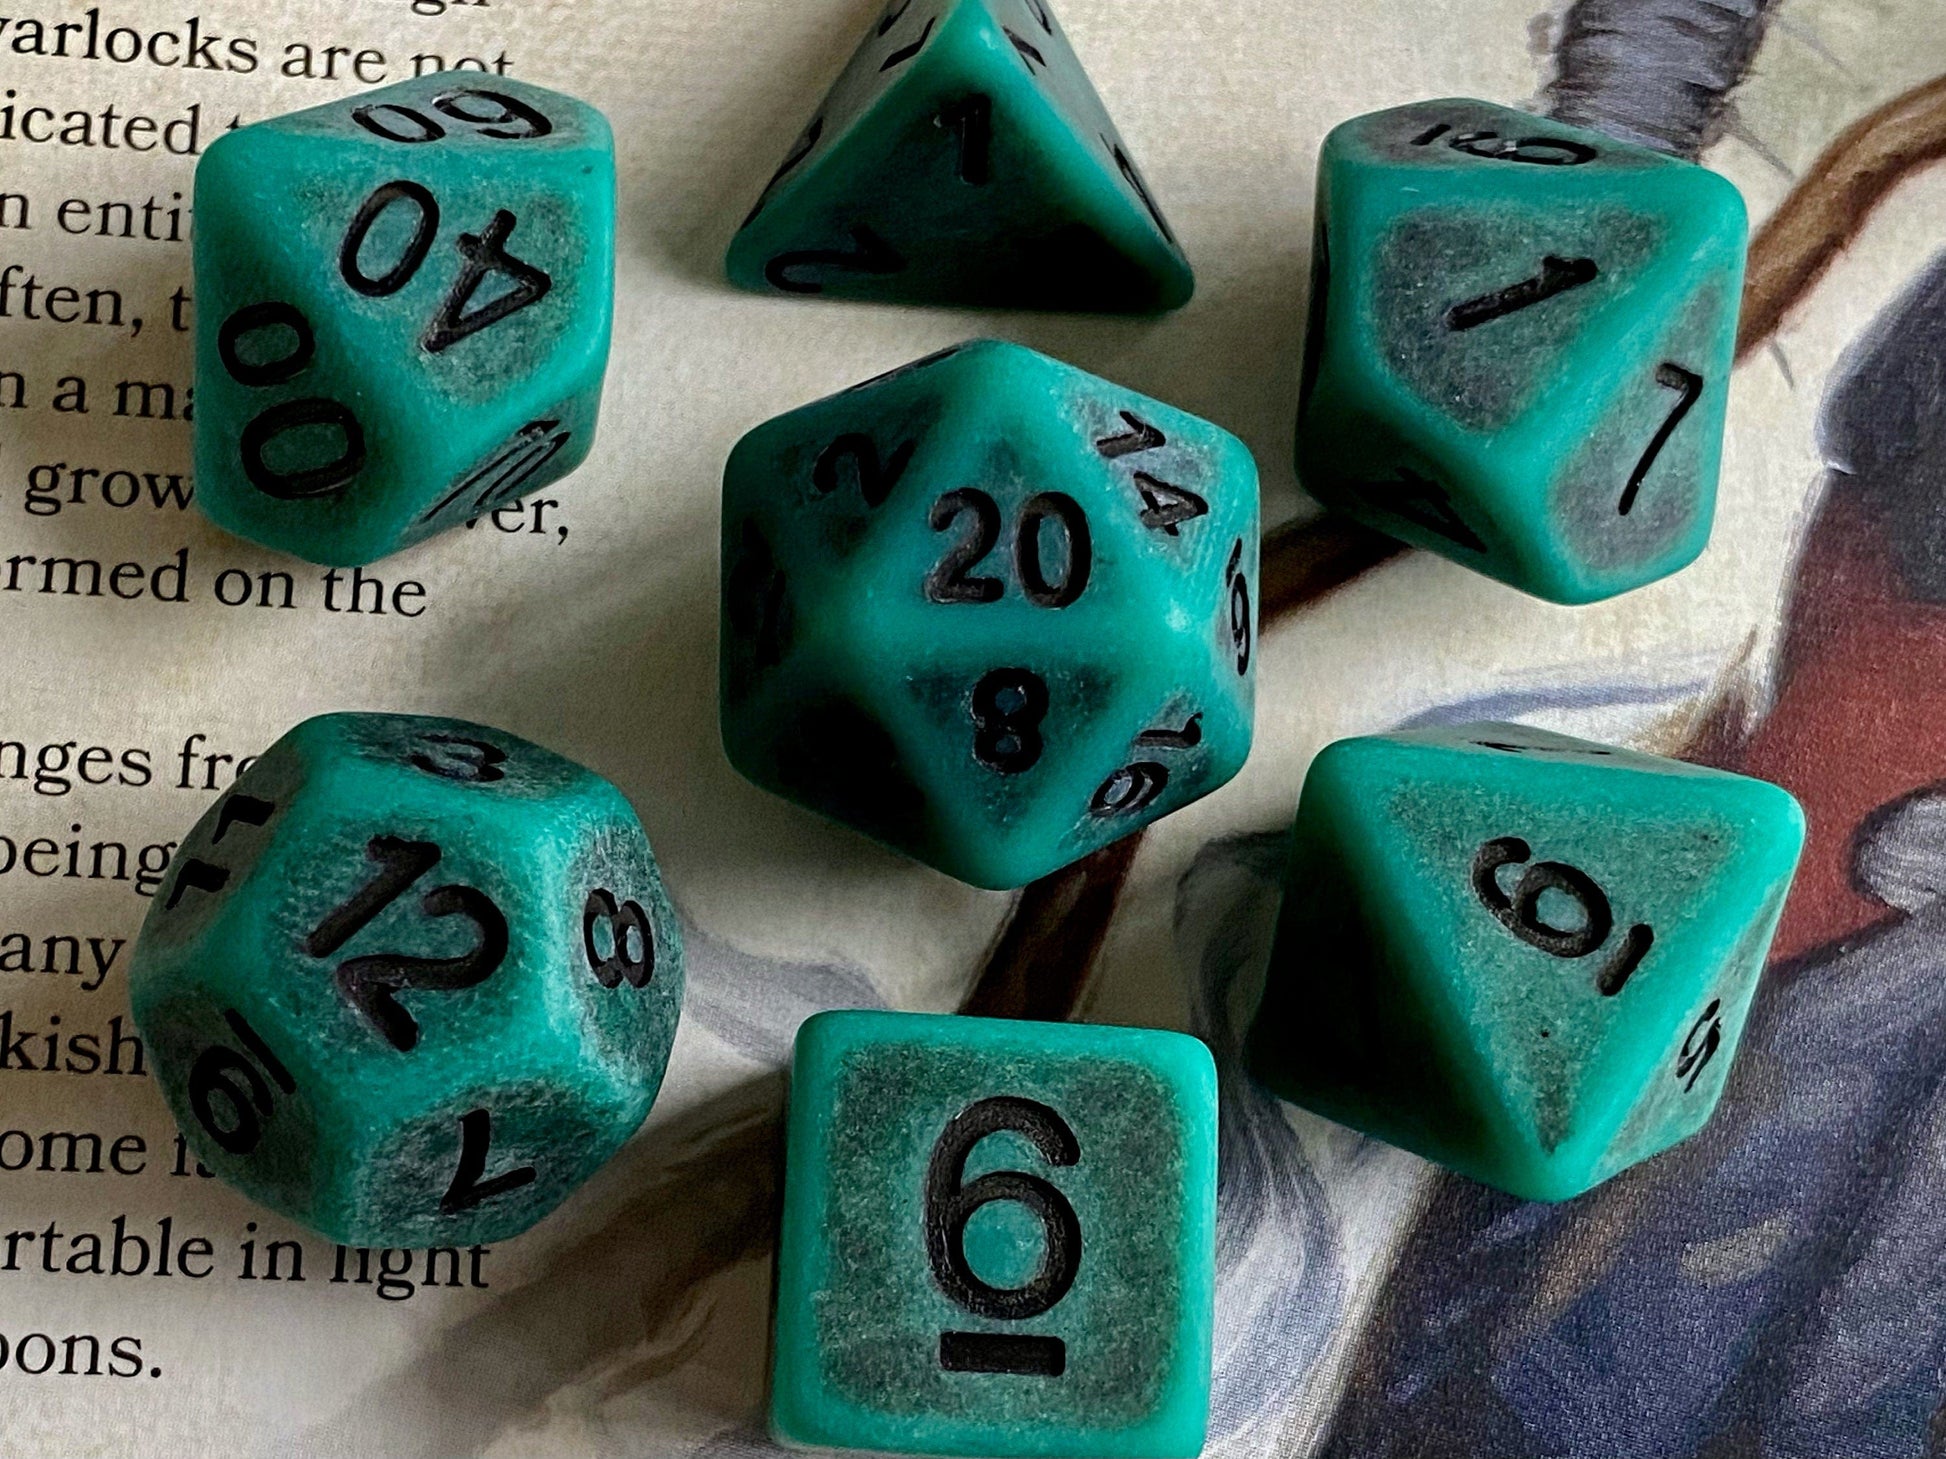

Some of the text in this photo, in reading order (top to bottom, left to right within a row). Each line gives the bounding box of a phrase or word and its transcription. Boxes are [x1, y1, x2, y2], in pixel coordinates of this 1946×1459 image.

[281, 44, 386, 84] are
[0, 88, 200, 155] icated
[933, 93, 993, 185] 1
[57, 192, 193, 242] enti
[0, 264, 143, 337] ften,
[338, 180, 552, 352] 40
[1448, 255, 1598, 333] 1
[52, 375, 89, 414] a
[812, 431, 917, 509] 2
[1617, 362, 1704, 516] 7
[466, 497, 569, 546] er,
[926, 486, 1093, 609] 20
[213, 568, 297, 610] on
[322, 566, 428, 618] the
[970, 666, 1050, 775] 8
[0, 933, 126, 991] any
[307, 835, 508, 1053] 12
[582, 886, 655, 988] 8
[0, 1009, 147, 1076] kish
[0, 1129, 146, 1175] ome
[0, 1214, 214, 1279] rtable
[238, 1221, 305, 1282] in
[924, 1095, 1083, 1378] 6
